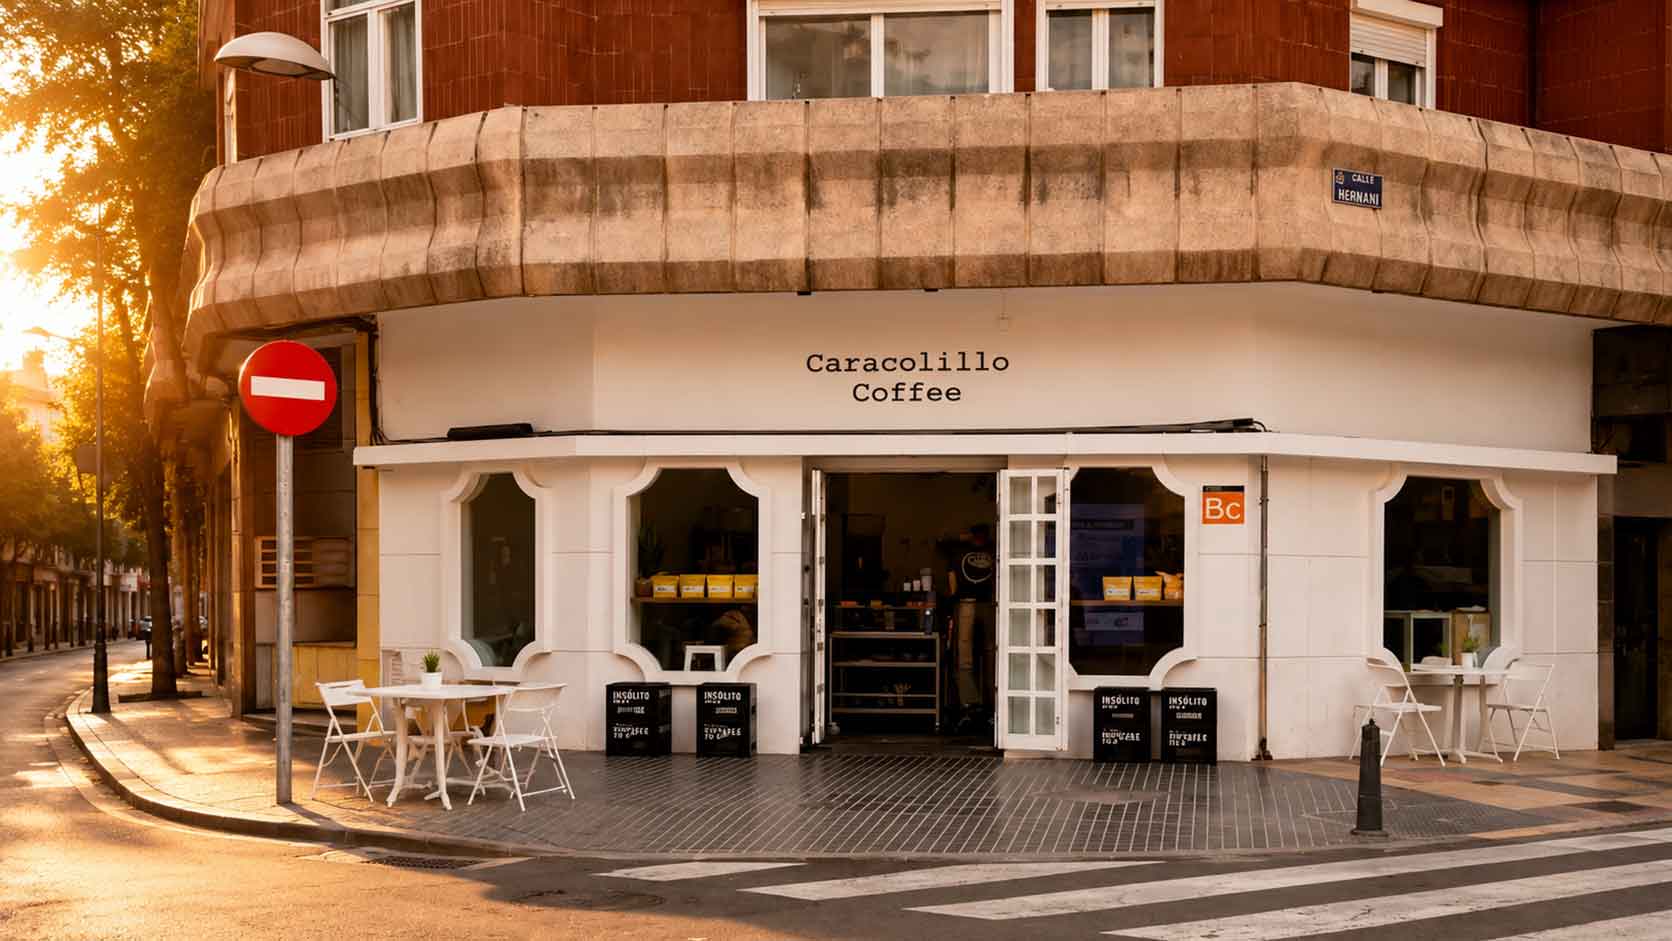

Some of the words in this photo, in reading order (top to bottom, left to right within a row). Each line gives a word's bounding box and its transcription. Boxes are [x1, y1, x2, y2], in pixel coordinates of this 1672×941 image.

[1351, 173, 1375, 185] CALLE
[1338, 188, 1380, 206] HERNANI
[806, 351, 1010, 373] Caracolillo
[852, 382, 962, 402] Coffee
[1205, 497, 1241, 520] Bc
